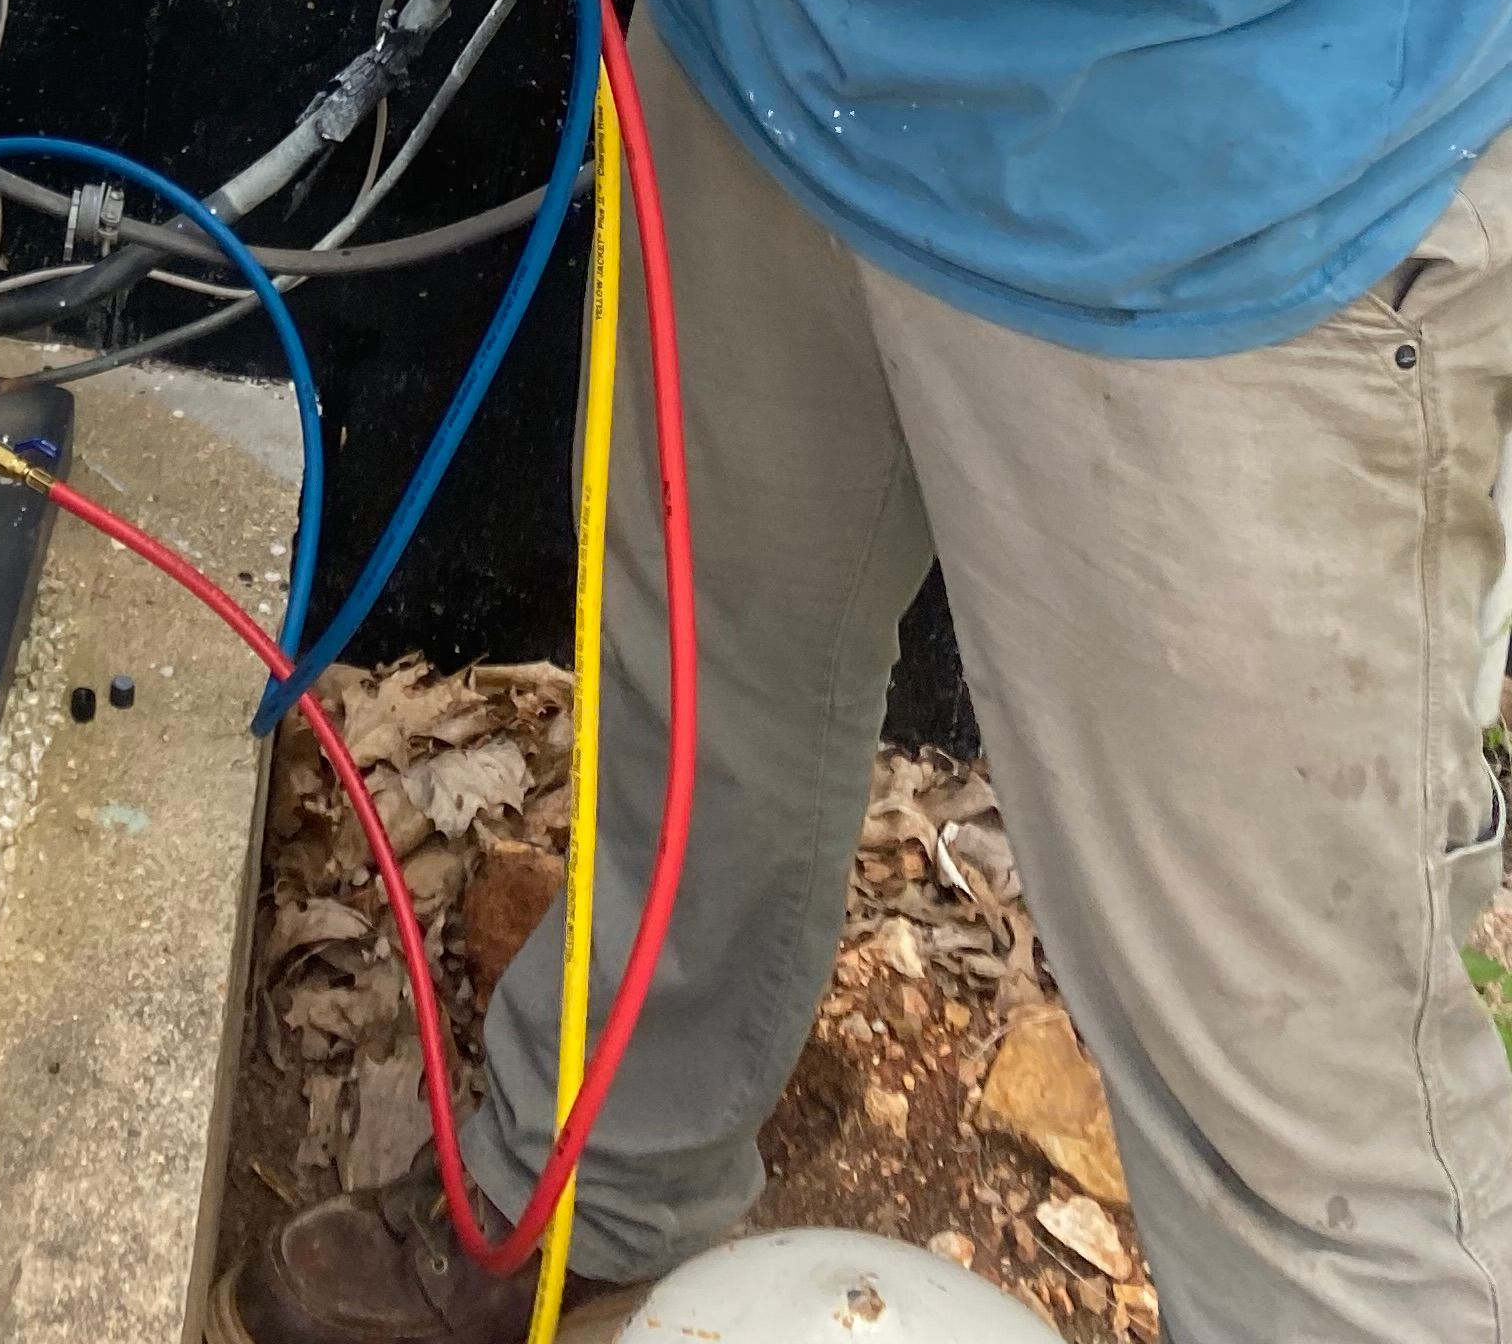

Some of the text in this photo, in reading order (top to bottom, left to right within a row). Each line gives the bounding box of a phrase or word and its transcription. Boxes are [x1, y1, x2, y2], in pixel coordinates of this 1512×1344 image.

[596, 105, 605, 129] Hose
[596, 132, 605, 176] Charging
[596, 208, 605, 229] Plus
[595, 280, 604, 321] YELLOW
